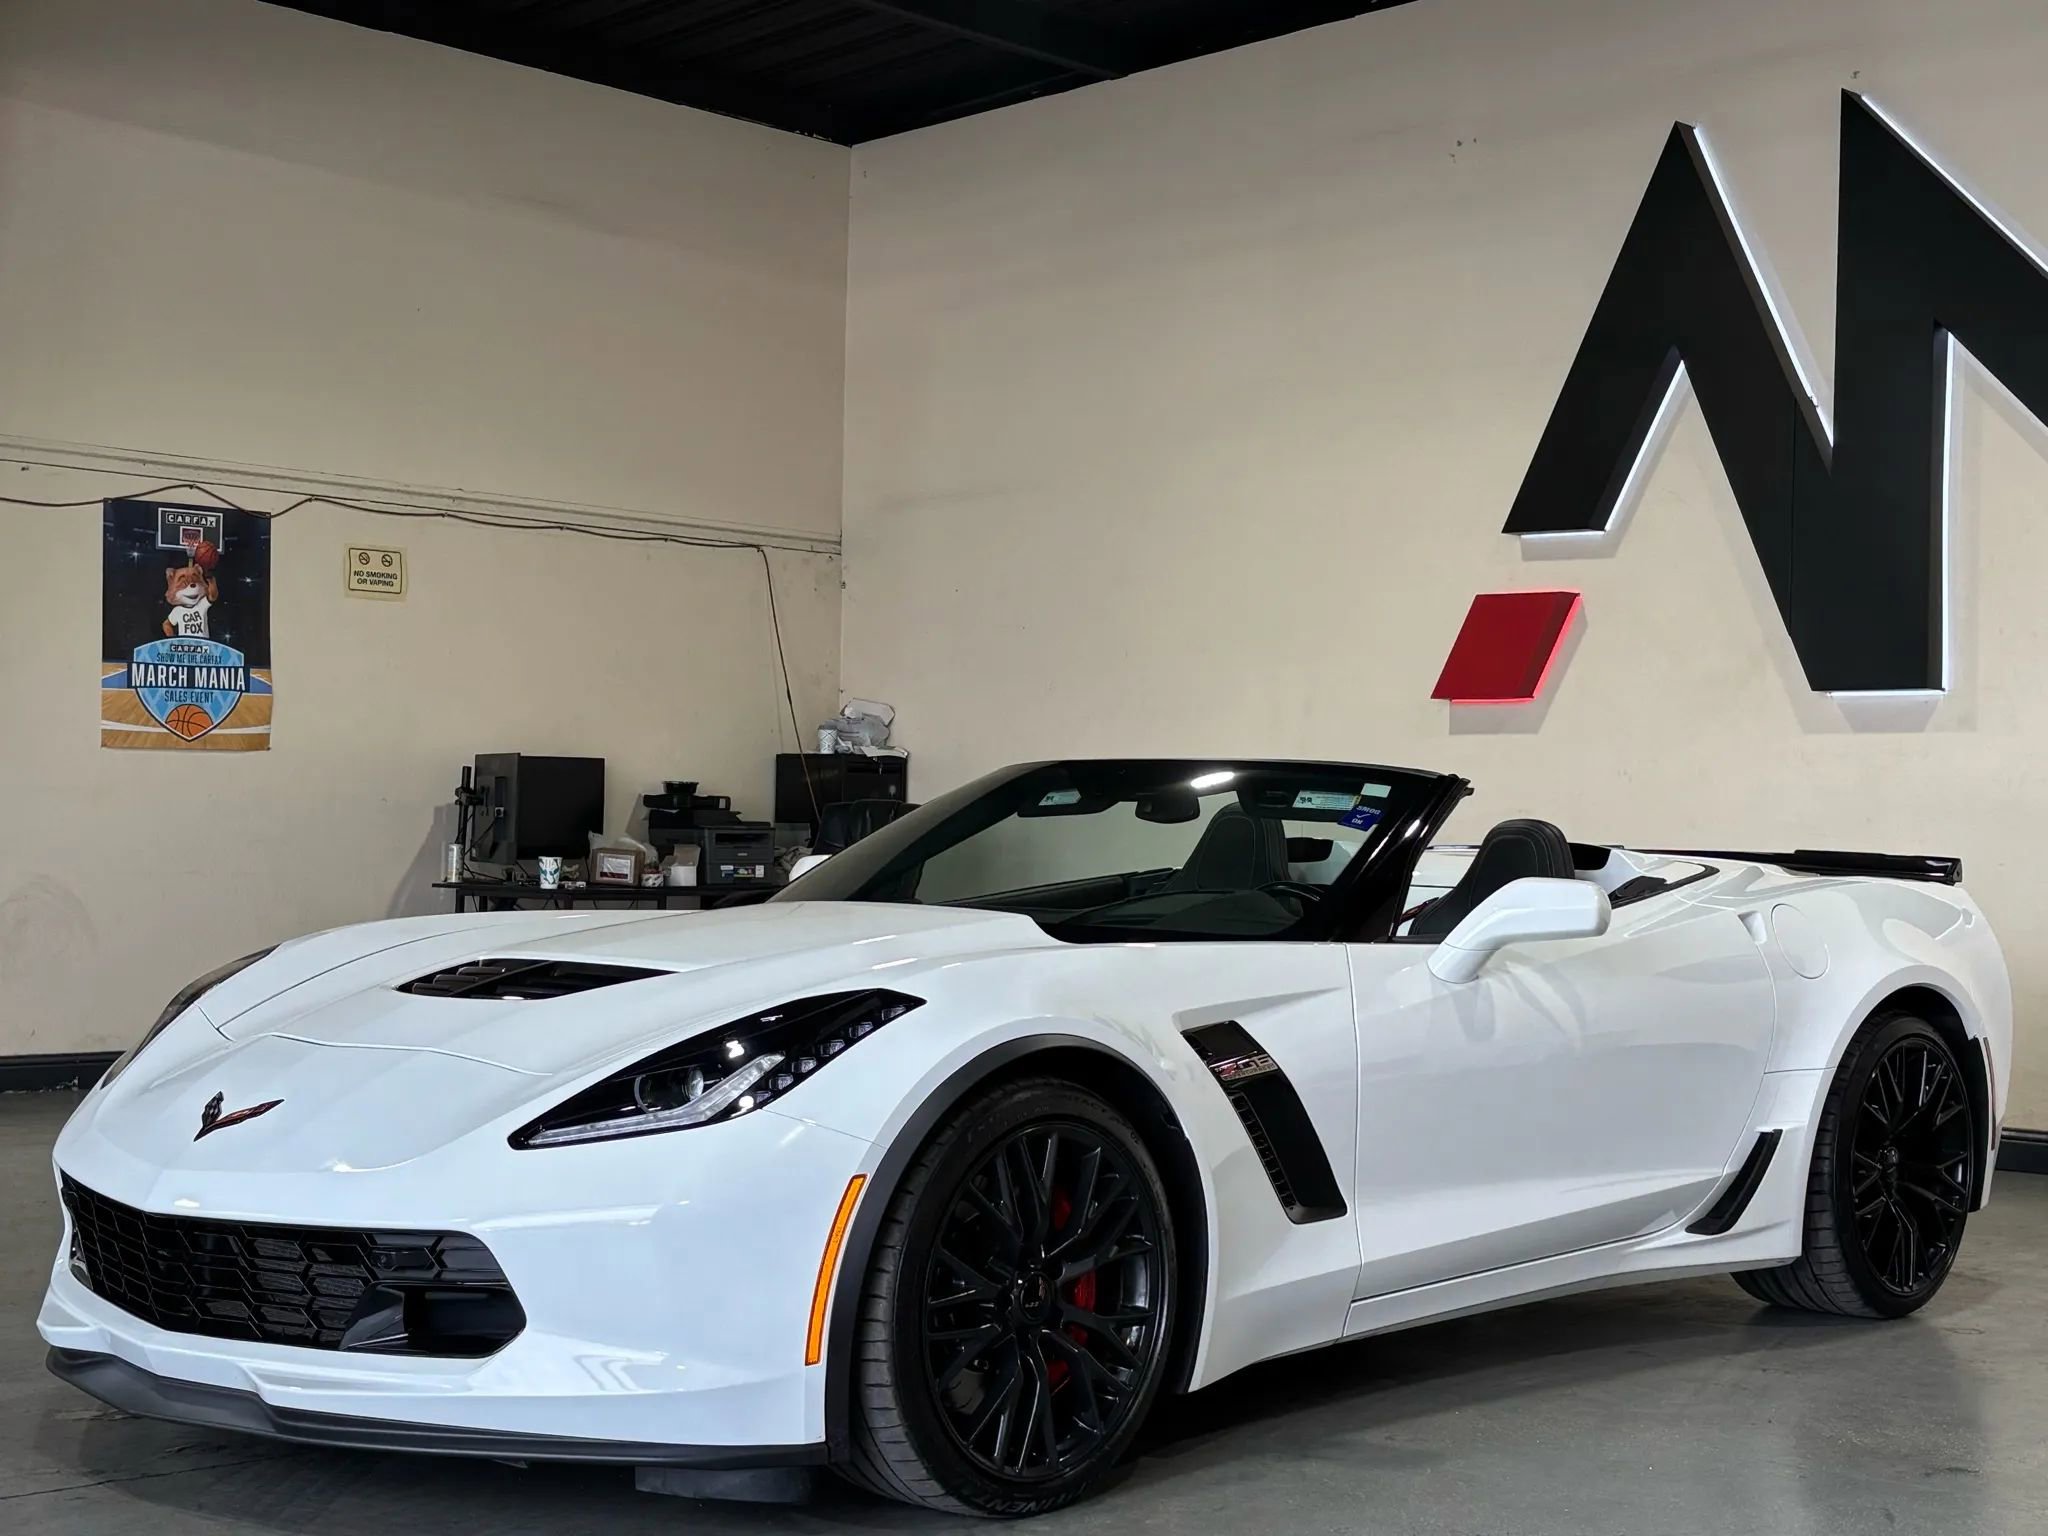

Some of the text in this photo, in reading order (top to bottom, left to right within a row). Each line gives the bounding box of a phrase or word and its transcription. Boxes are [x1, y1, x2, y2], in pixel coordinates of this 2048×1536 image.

[167, 513, 216, 527] CARFAX
[366, 571, 398, 580] SMOKING
[369, 579, 394, 587] VAPING
[182, 611, 202, 623] CAR
[184, 621, 203, 634] FOX
[171, 645, 209, 654] CARFAX
[156, 652, 222, 665] SHOW ME THE CARFAX
[131, 663, 246, 691] MARCH MANIA
[164, 690, 214, 704] SALES EVENT
[1356, 805, 1381, 815] SMOG
